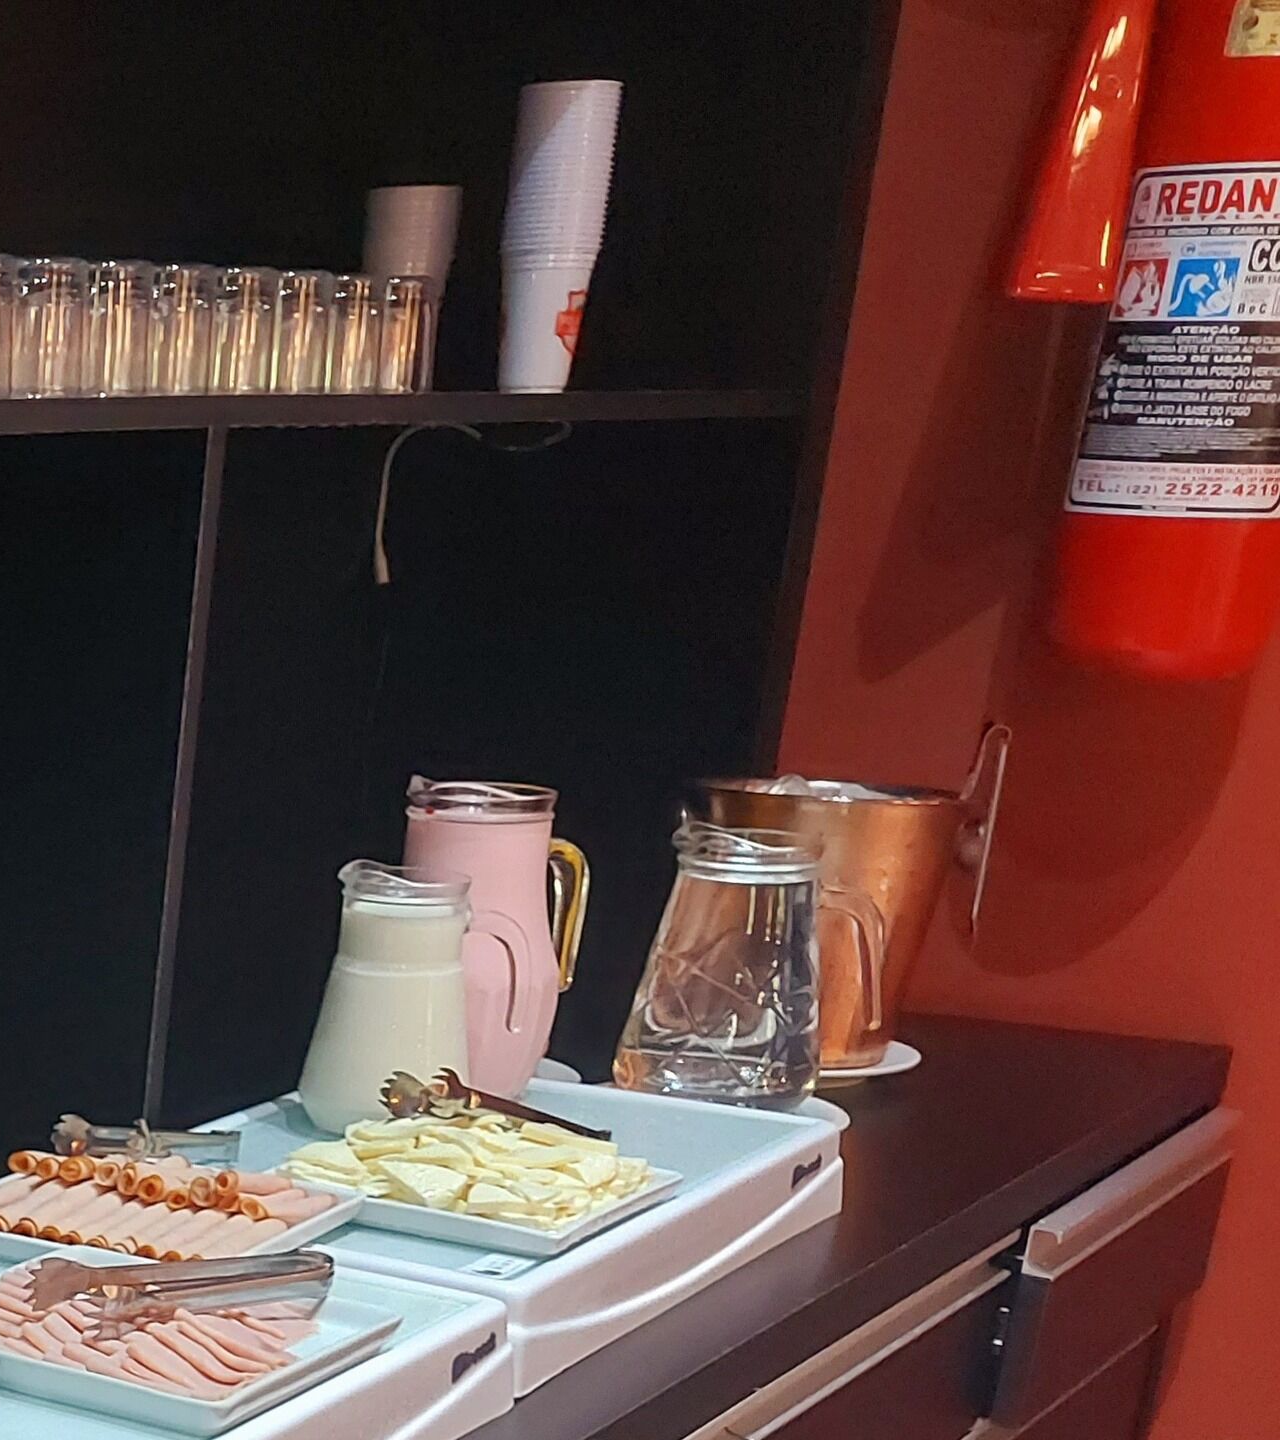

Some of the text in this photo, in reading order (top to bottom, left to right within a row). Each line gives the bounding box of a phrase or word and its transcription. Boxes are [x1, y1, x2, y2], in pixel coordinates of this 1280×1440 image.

[1156, 178, 1278, 215] REDAN
[1172, 325, 1240, 335] ATENÇÃO
[1190, 355, 1210, 363] DE
[1214, 355, 1252, 363] USAR
[1137, 416, 1235, 427] MANUTENÇÃO
[1126, 483, 1158, 495] (22)
